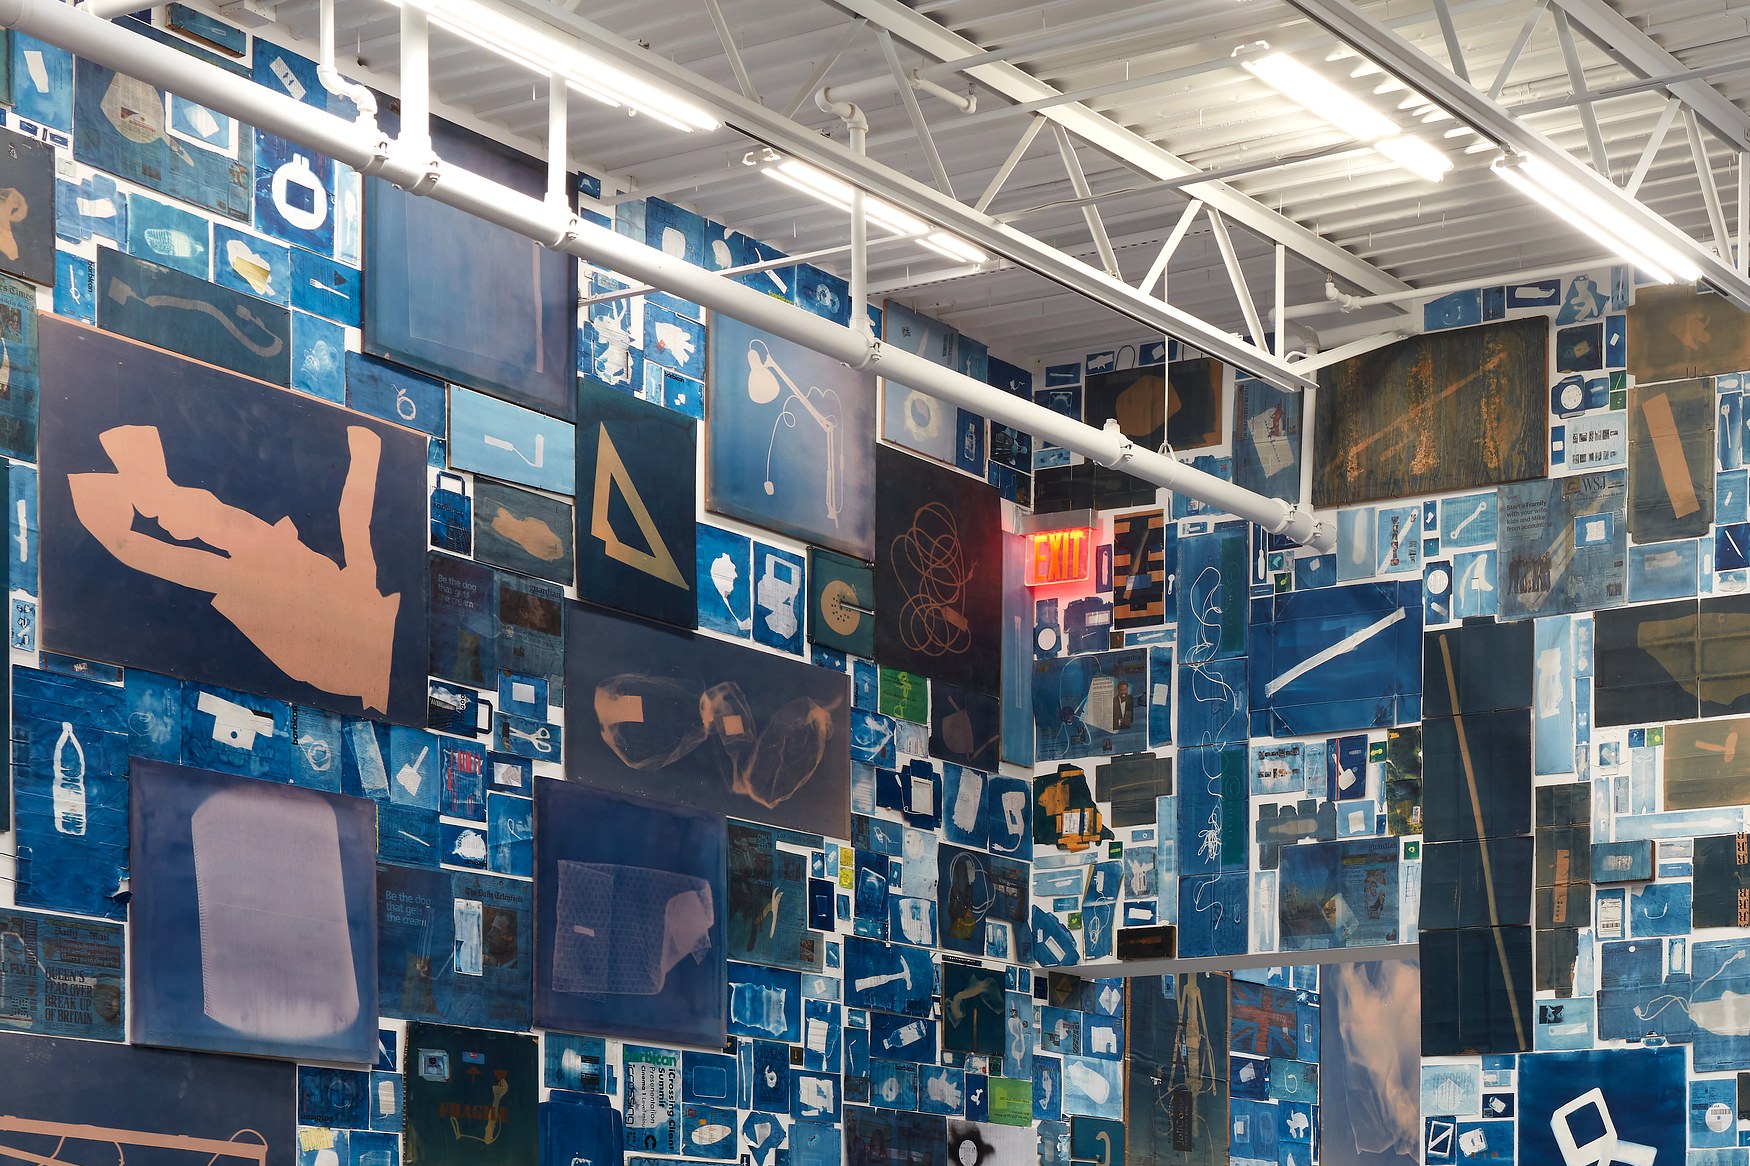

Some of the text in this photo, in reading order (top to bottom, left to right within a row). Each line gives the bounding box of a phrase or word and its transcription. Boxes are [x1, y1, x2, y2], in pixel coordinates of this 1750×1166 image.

[664, 370, 685, 383] barbican
[1582, 475, 1606, 492] WSJ
[1506, 502, 1522, 511] Start
[1525, 499, 1547, 509] Framily
[1507, 509, 1520, 517] with
[1520, 509, 1533, 517] your
[1531, 514, 1546, 522] Mike
[1034, 529, 1084, 582] EXIT
[437, 574, 477, 591] Be the dog
[437, 583, 453, 594] that
[438, 593, 451, 602] the
[529, 584, 561, 598] guardian
[1368, 842, 1397, 853] guardian
[386, 890, 432, 907] Be the dog
[464, 888, 524, 903] The Daily Telegraph
[386, 902, 423, 915] that gets
[386, 913, 428, 926] the cream
[54, 928, 110, 941] Daily Mail
[9, 963, 38, 976] FIX IT
[45, 966, 85, 983] QUEEN'S
[45, 980, 93, 998] FEAR OVER
[45, 994, 92, 1011] BREAK UP
[45, 1008, 93, 1025] OF BRITAIN
[895, 1064, 917, 1073] barbican
[658, 1067, 666, 1108] Summit
[667, 1068, 676, 1150] iCrossing Client
